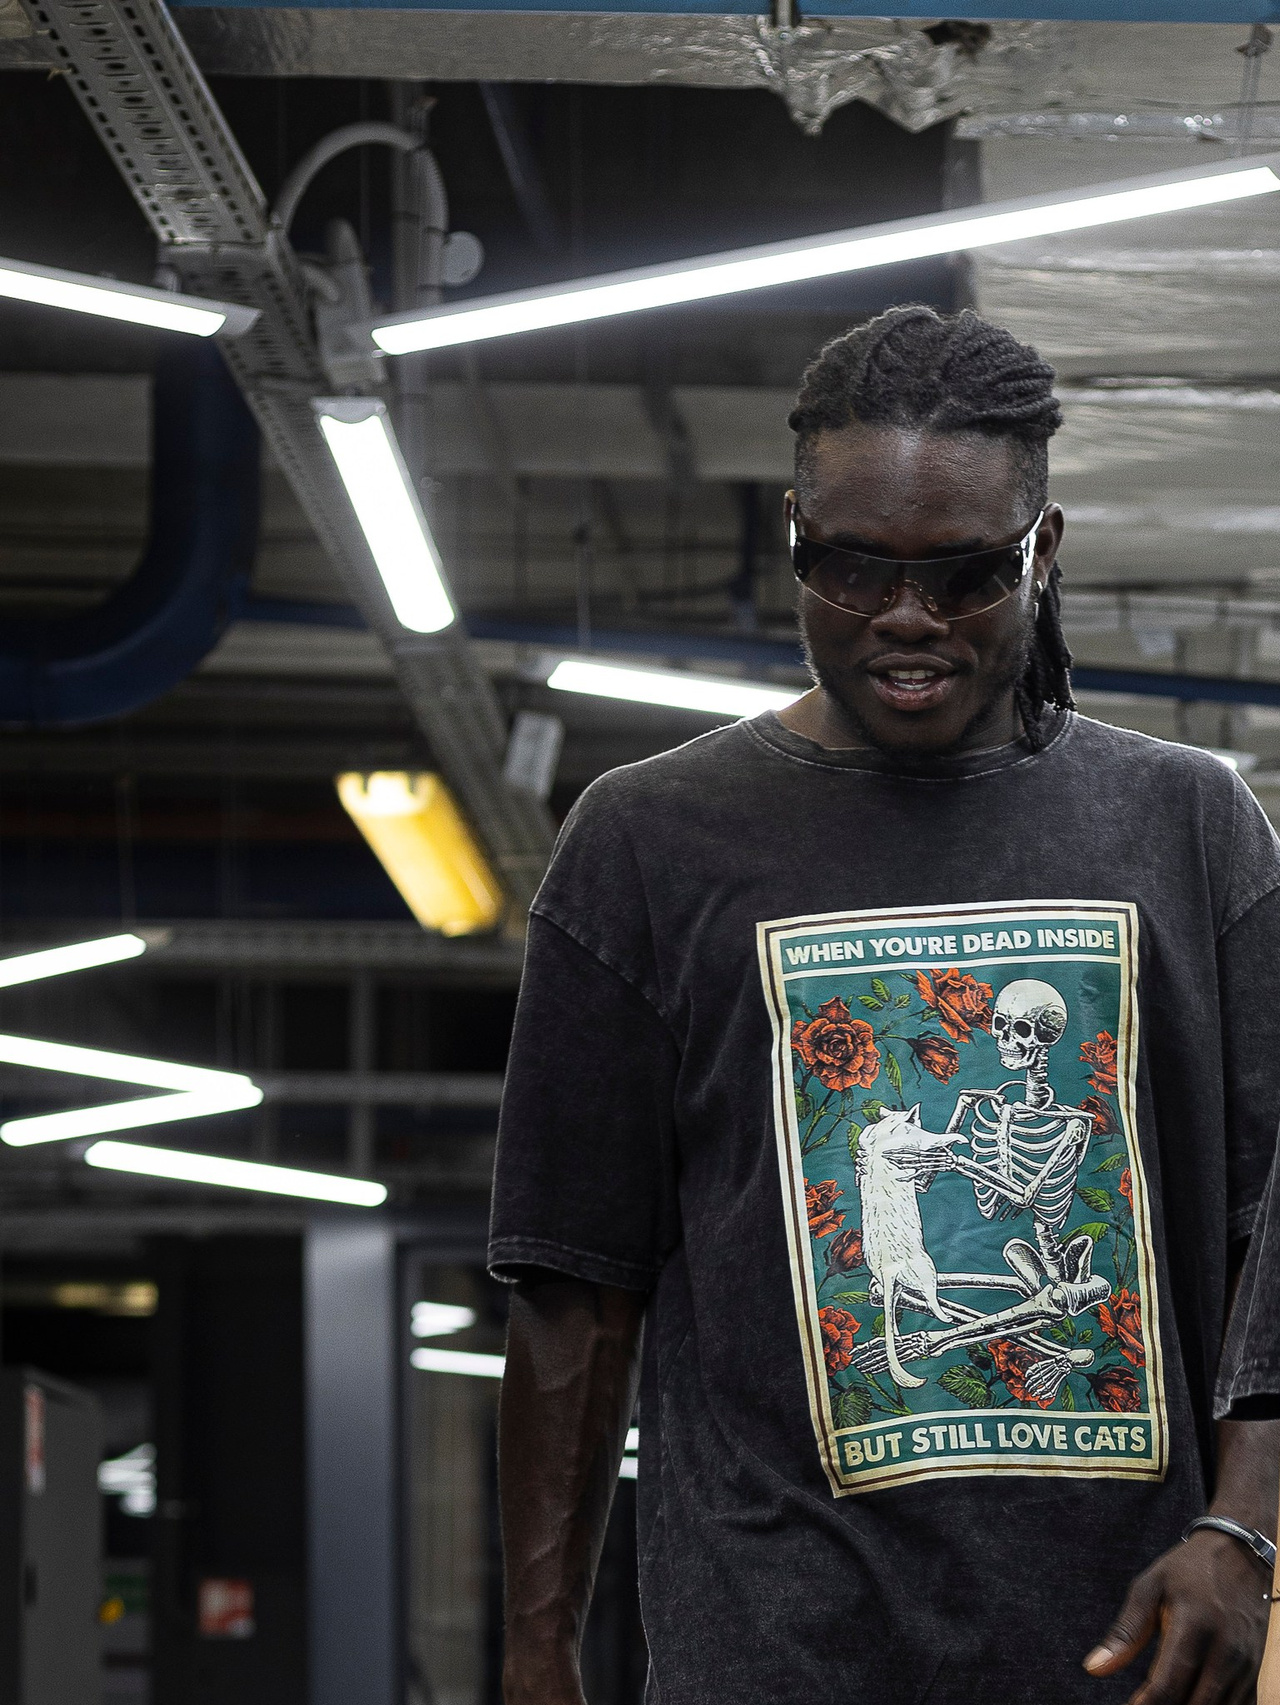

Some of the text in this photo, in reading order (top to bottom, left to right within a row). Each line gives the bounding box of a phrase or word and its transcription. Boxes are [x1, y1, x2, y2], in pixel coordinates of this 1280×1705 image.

[785, 928, 1115, 965] WHEN YOU'RE DEAD INSIDE
[844, 1422, 1146, 1467] BUT STILL LOVE CATS
